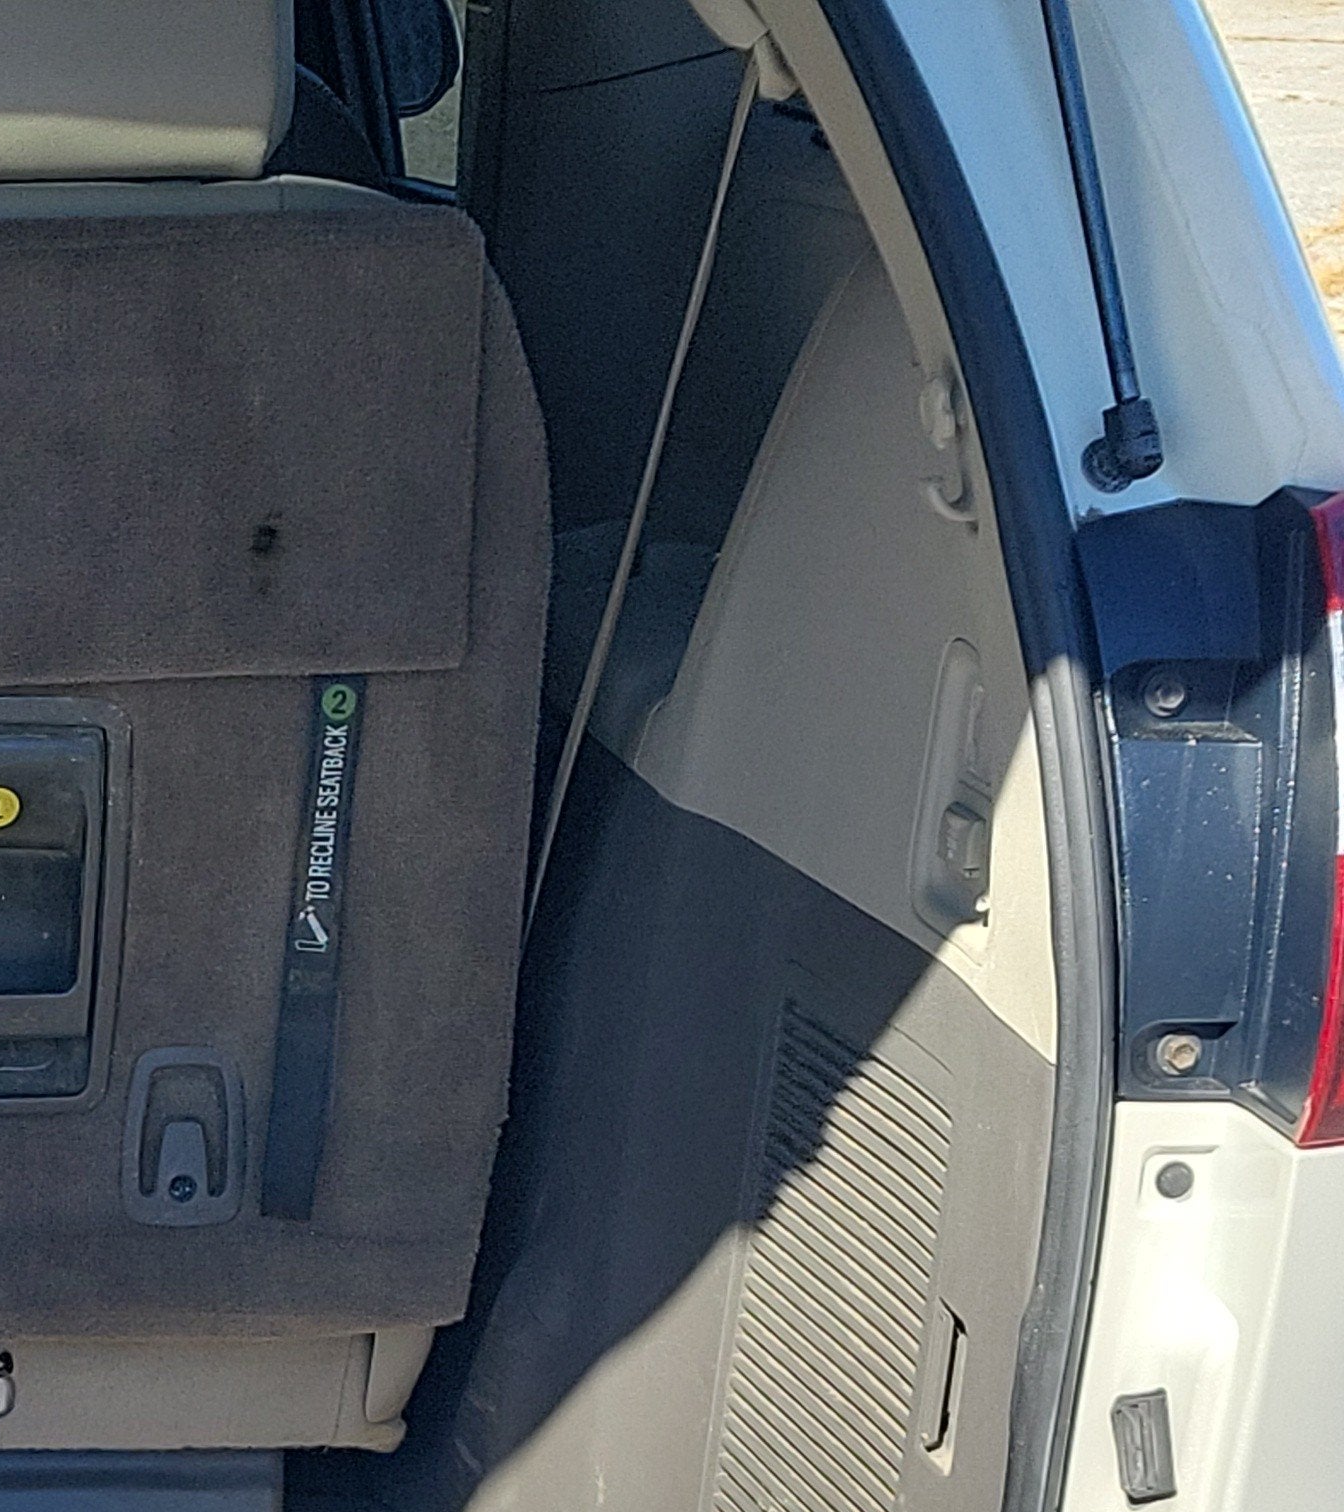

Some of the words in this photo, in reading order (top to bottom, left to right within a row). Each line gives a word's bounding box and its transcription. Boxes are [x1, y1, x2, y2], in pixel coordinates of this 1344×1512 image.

[331, 690, 348, 714] 2
[317, 724, 349, 807] SEATBACK
[308, 810, 337, 876] RECLINE
[305, 880, 330, 901] TO
